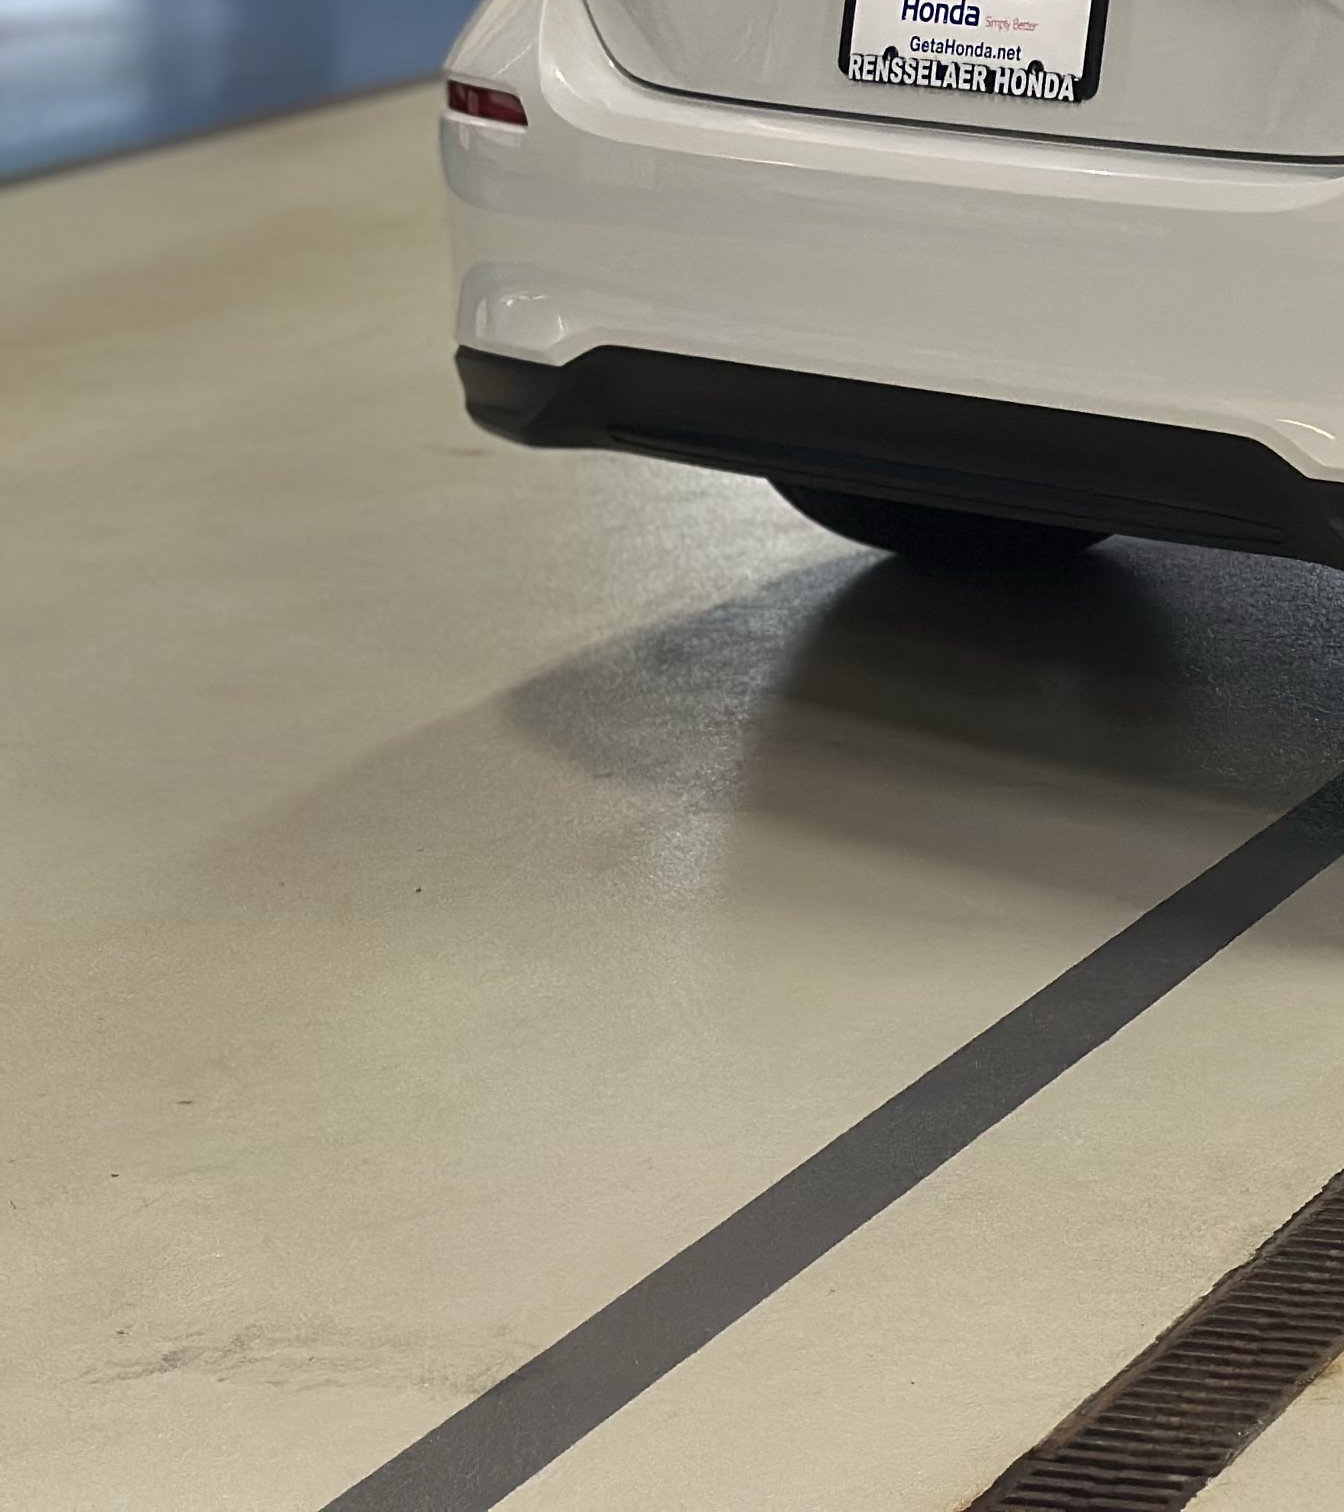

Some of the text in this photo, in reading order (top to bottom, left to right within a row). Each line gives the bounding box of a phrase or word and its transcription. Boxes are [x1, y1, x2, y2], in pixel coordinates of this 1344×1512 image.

[910, 35, 1022, 61] GetaHonda.net
[848, 53, 1075, 101] RENSSELAER HONDA
